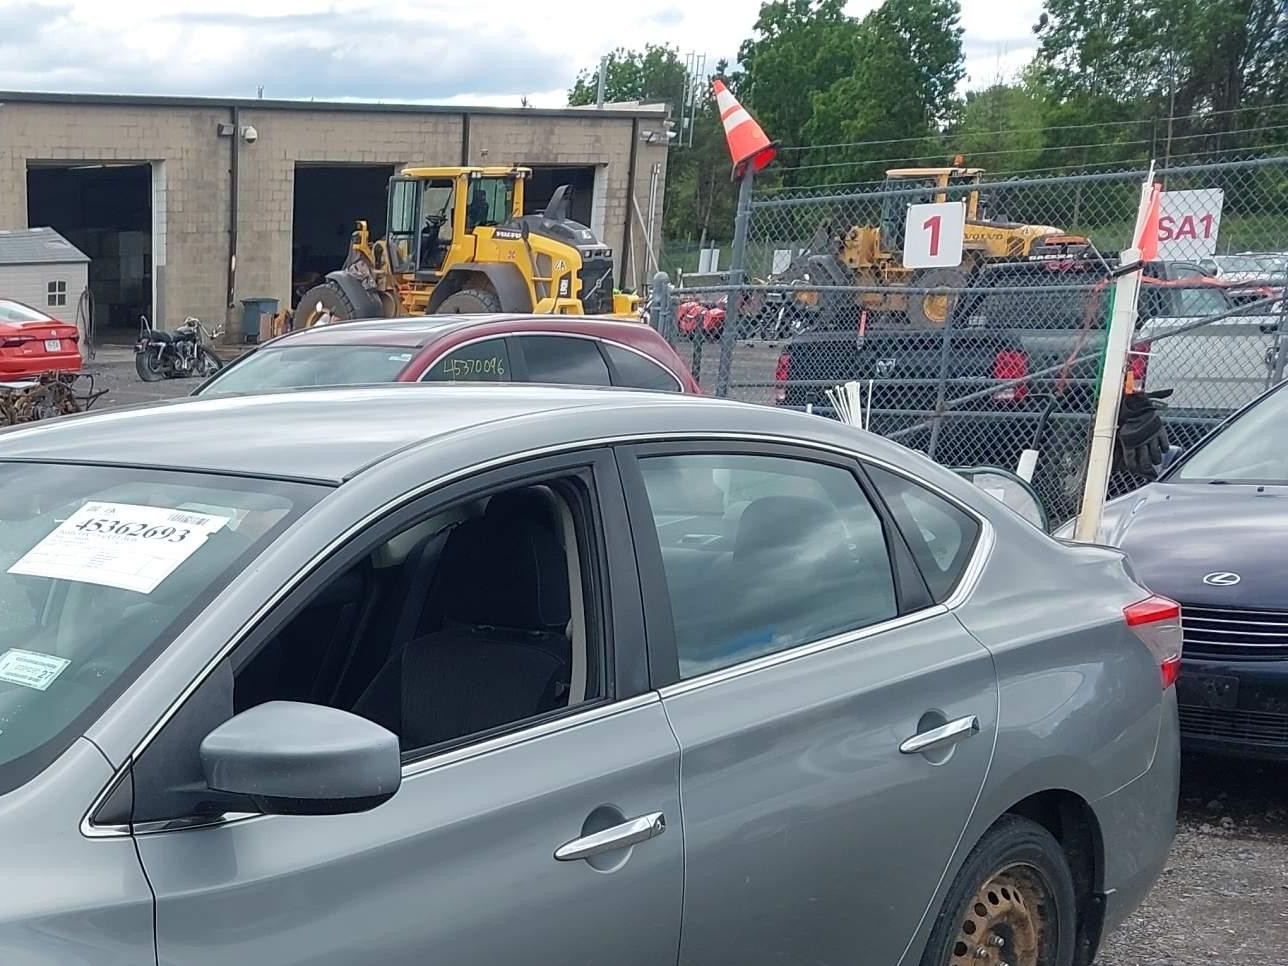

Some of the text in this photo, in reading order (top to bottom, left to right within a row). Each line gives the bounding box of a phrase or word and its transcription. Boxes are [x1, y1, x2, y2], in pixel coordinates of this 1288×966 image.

[923, 215, 942, 256] 1
[1158, 213, 1214, 241] SA1
[443, 357, 505, 379] 45370096
[75, 518, 192, 543] 45362693
